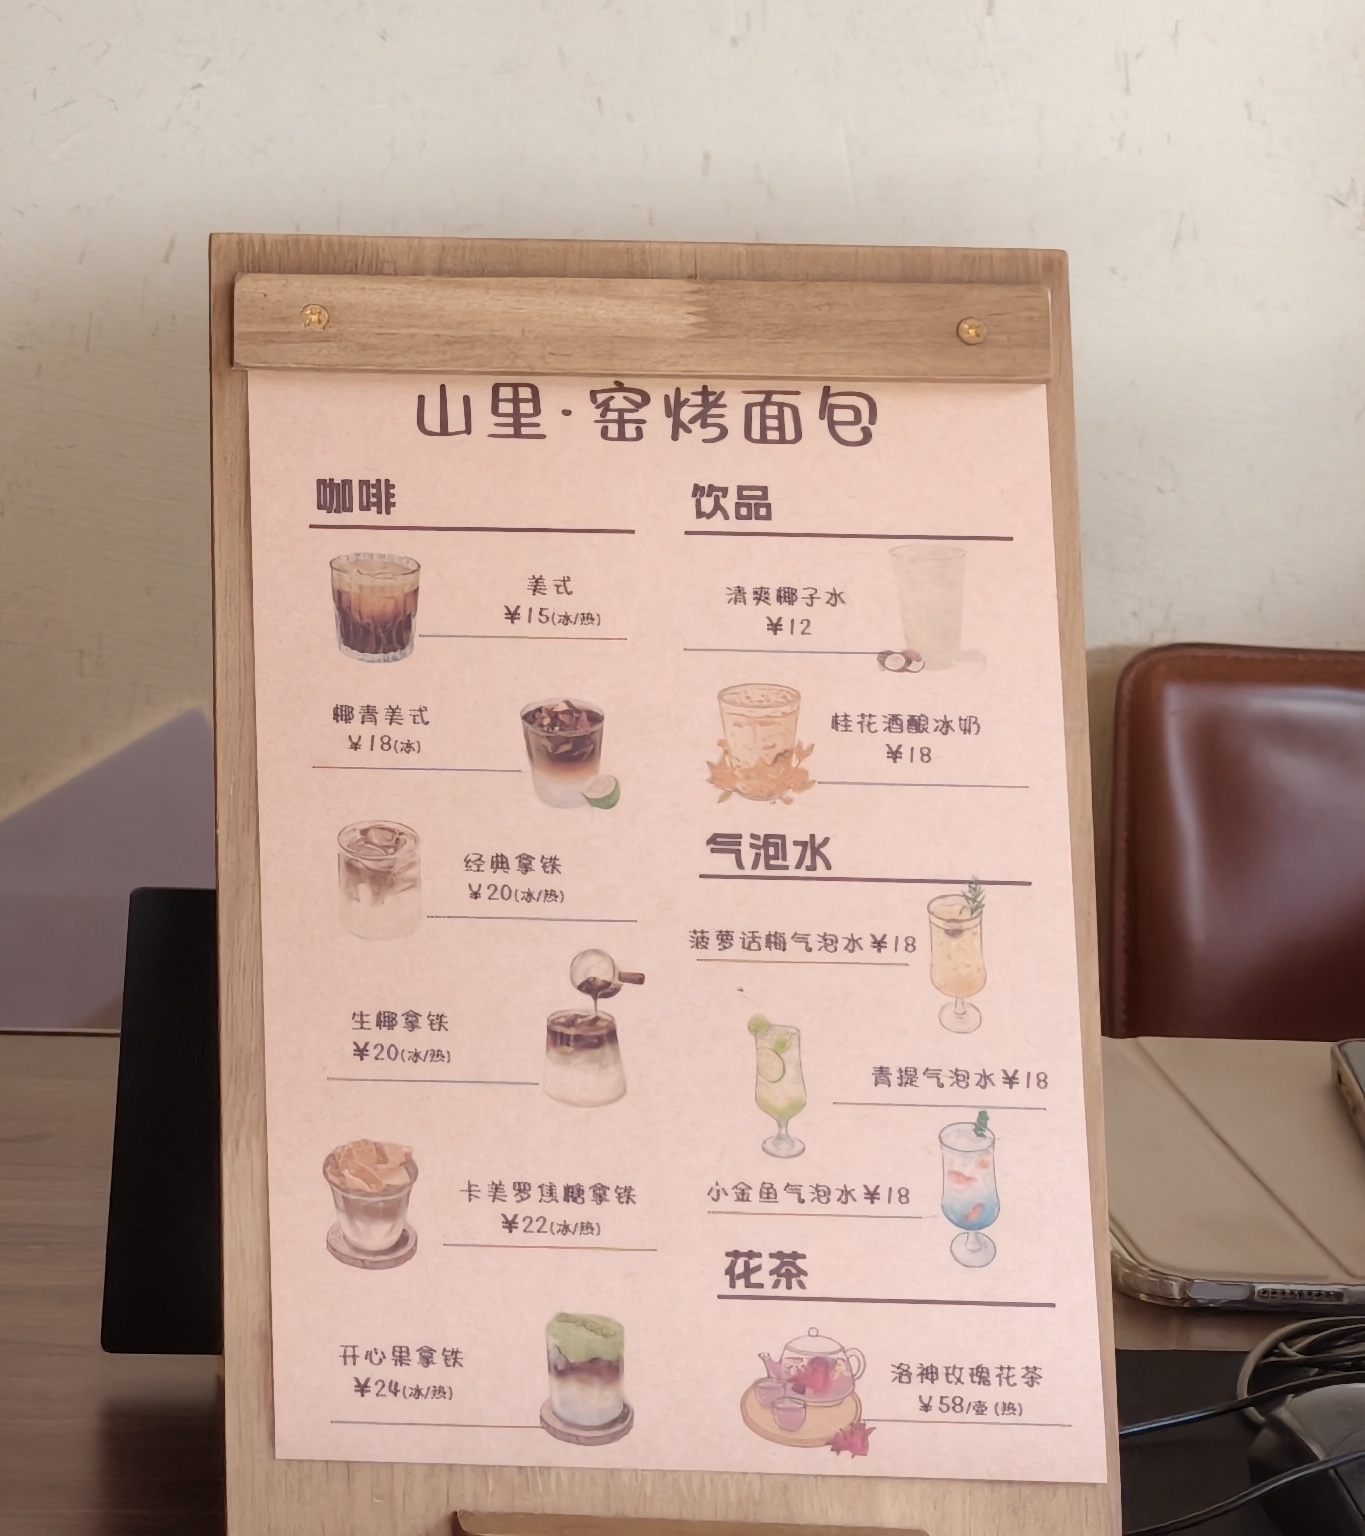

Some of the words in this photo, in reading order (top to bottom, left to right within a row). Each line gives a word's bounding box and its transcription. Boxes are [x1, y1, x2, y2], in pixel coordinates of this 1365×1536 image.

[317, 478, 396, 515] 咖啡
[691, 483, 772, 521] 饮品
[527, 575, 573, 596] 美式
[726, 586, 845, 607] 清爽椰子水
[766, 616, 811, 635] ¥12
[333, 704, 429, 726] 椰青美式
[831, 713, 980, 735] 桂花酒酿冰奶
[886, 744, 931, 763] ¥18
[706, 833, 832, 871] 气泡水
[464, 853, 561, 875] 经典拿铁
[352, 1010, 448, 1032] 生椰拿铁
[725, 1250, 808, 1290] 花茶
[339, 1345, 463, 1368] 开心果拿铁
[891, 1363, 1042, 1388] 洛神玫瑰花茶
